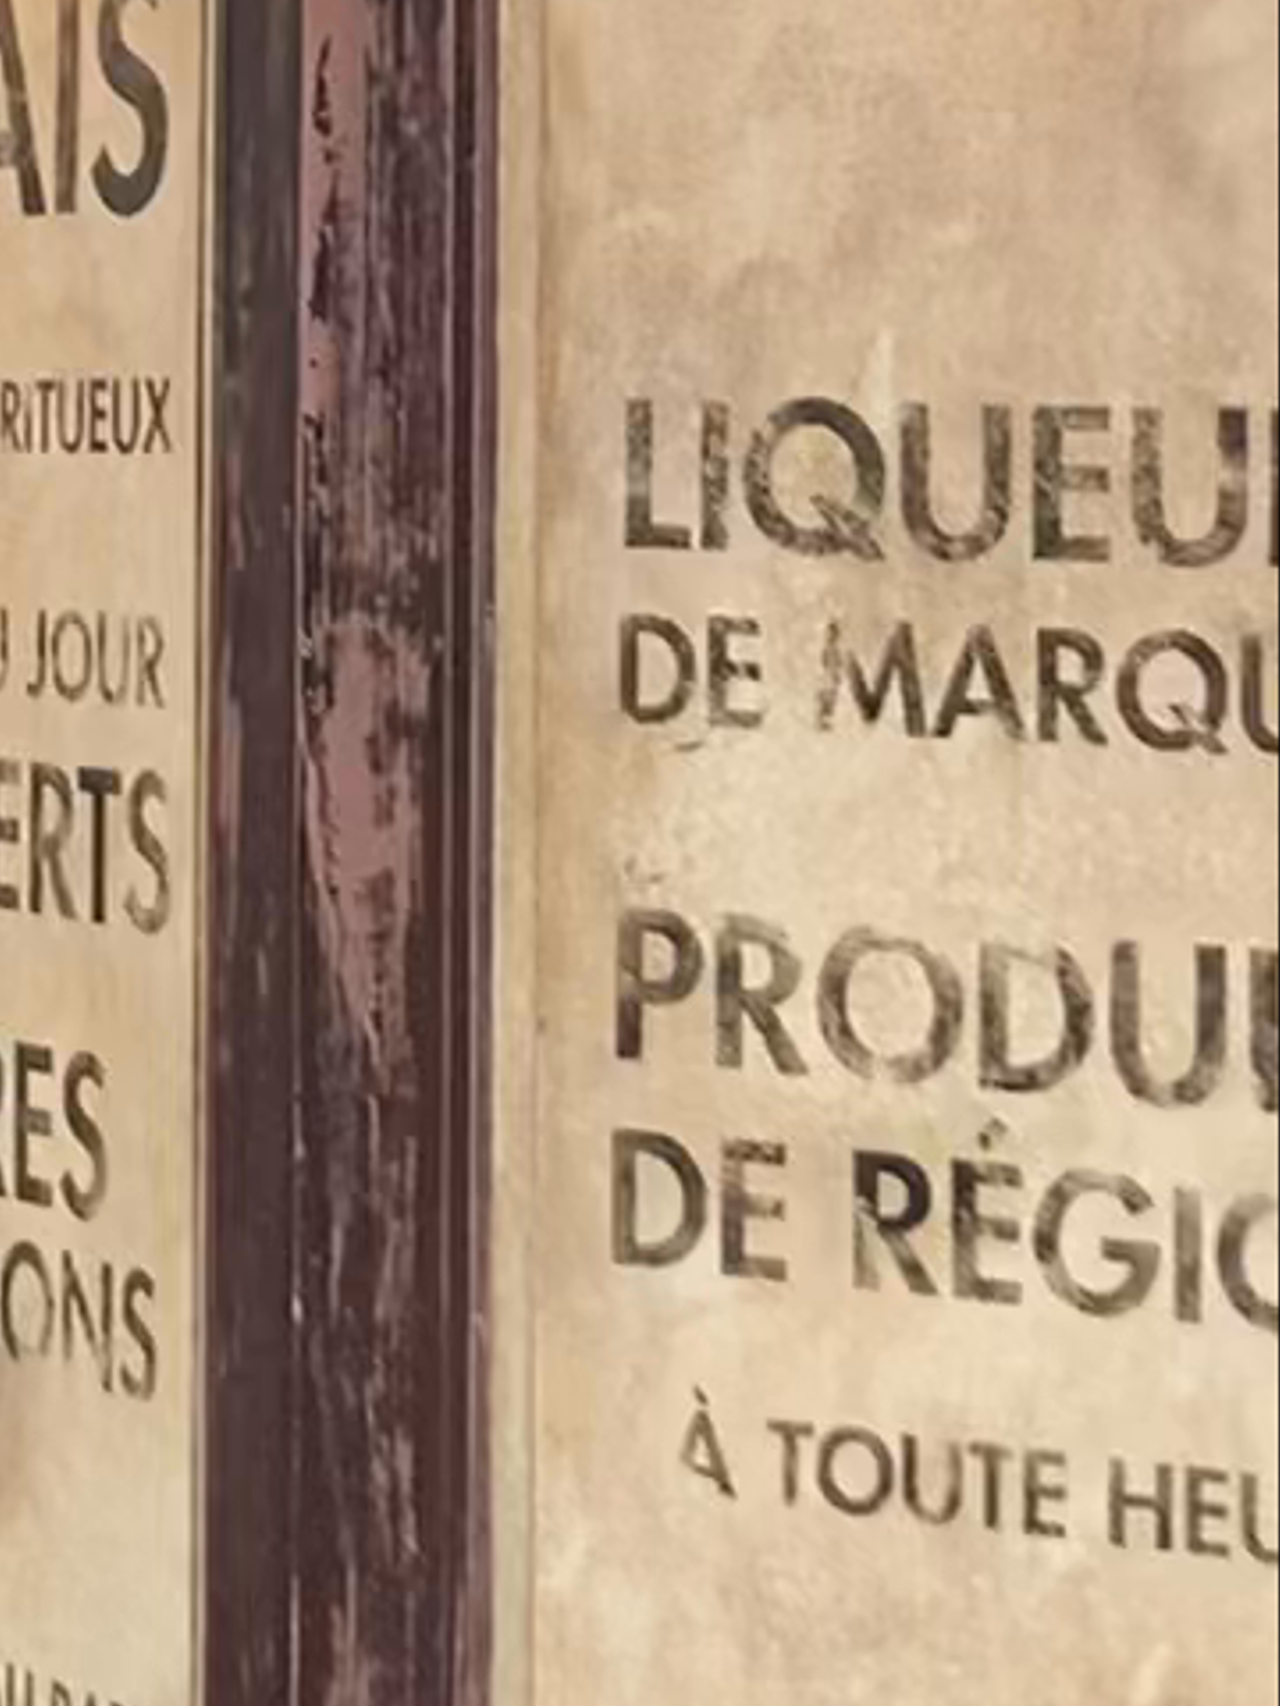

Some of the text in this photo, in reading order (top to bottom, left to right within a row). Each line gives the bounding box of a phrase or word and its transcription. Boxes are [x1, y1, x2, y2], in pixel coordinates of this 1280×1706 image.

[623, 396, 1278, 568] LIQUEU
[26, 607, 166, 709] JOUR
[618, 613, 763, 728] DE
[611, 1127, 788, 1281] DE
[679, 1383, 737, 1500] À
[765, 1417, 1067, 1538] TOUTE
